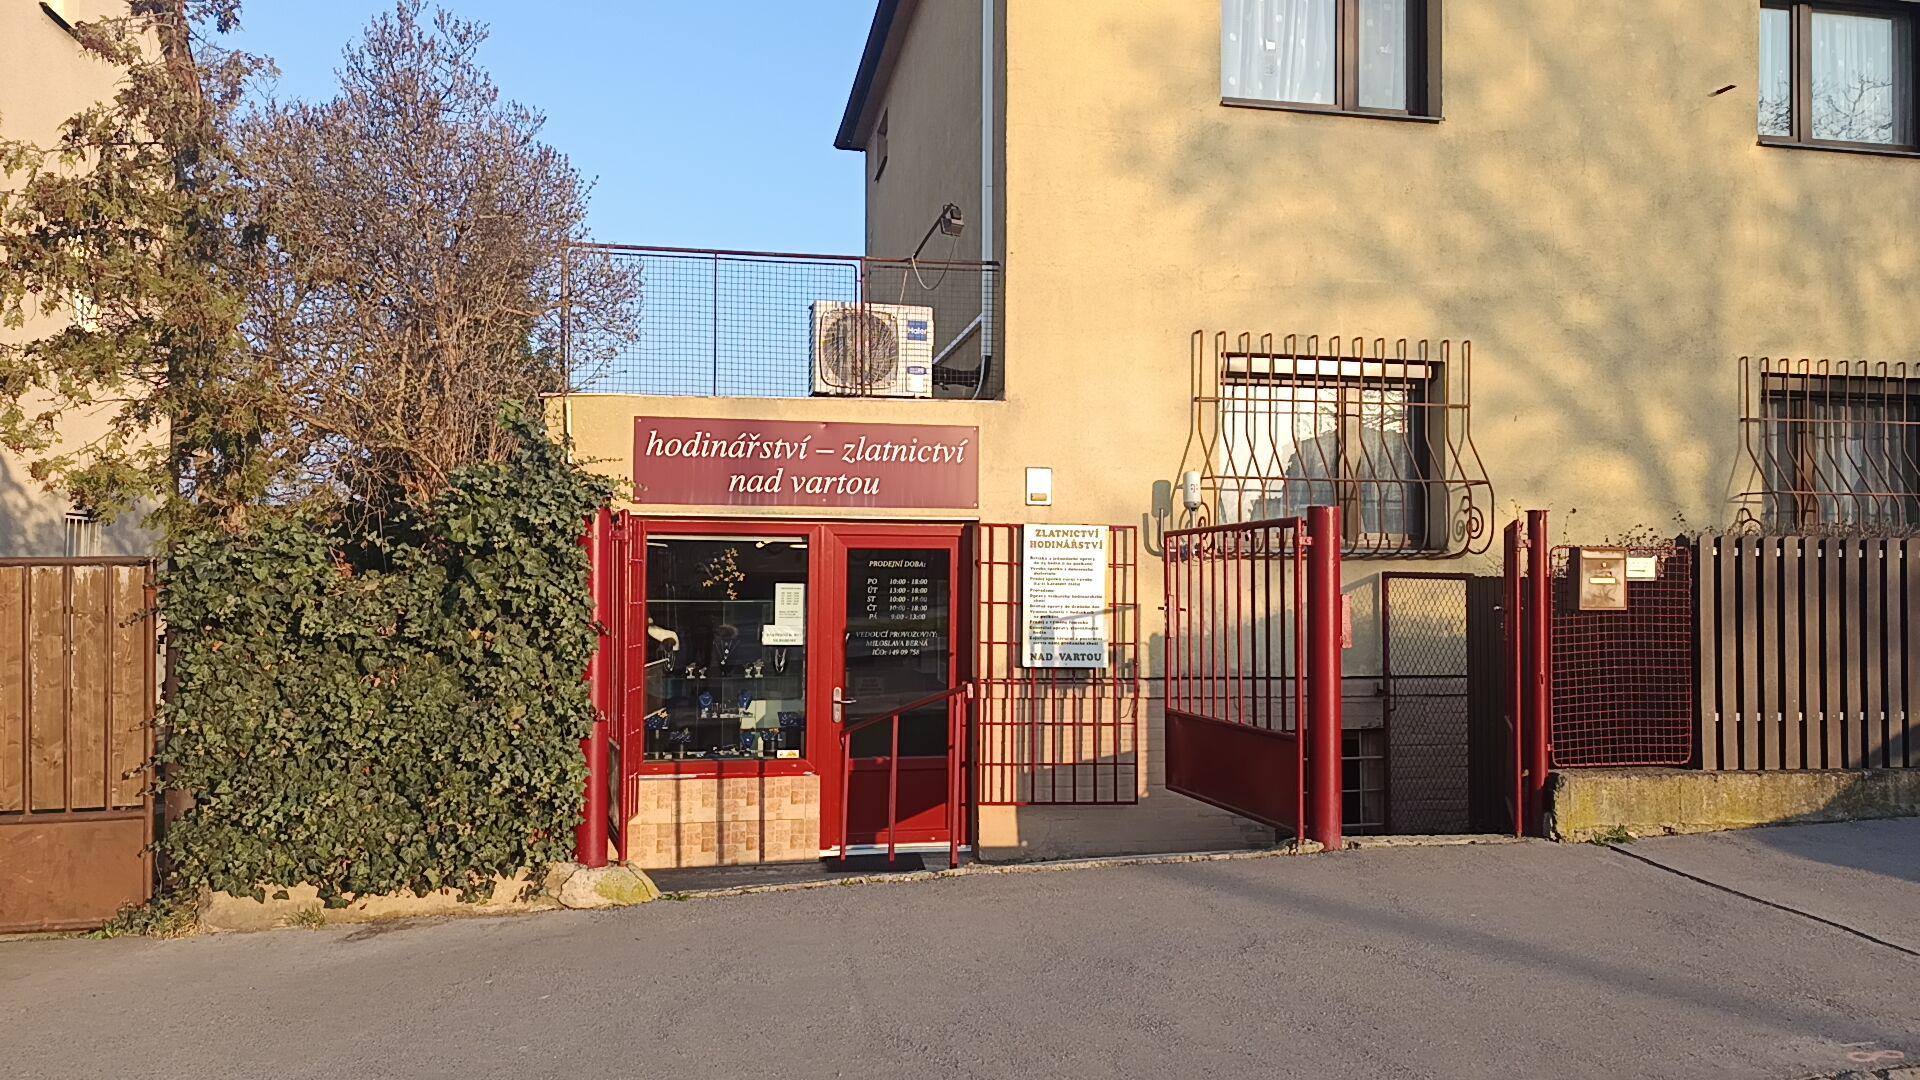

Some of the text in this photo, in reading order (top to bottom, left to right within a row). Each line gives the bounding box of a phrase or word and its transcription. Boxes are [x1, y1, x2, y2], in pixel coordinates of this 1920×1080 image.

[646, 431, 812, 460] hodinářství
[842, 436, 968, 464] zlatnictví
[729, 468, 880, 495] nad vartou
[1036, 529, 1099, 538] ZLATNICTVÍ
[1029, 539, 1103, 550] HODINÁŘSTVÍ
[869, 559, 903, 568] PRODEJNÍ
[1030, 653, 1102, 661] NAD VARTOU
